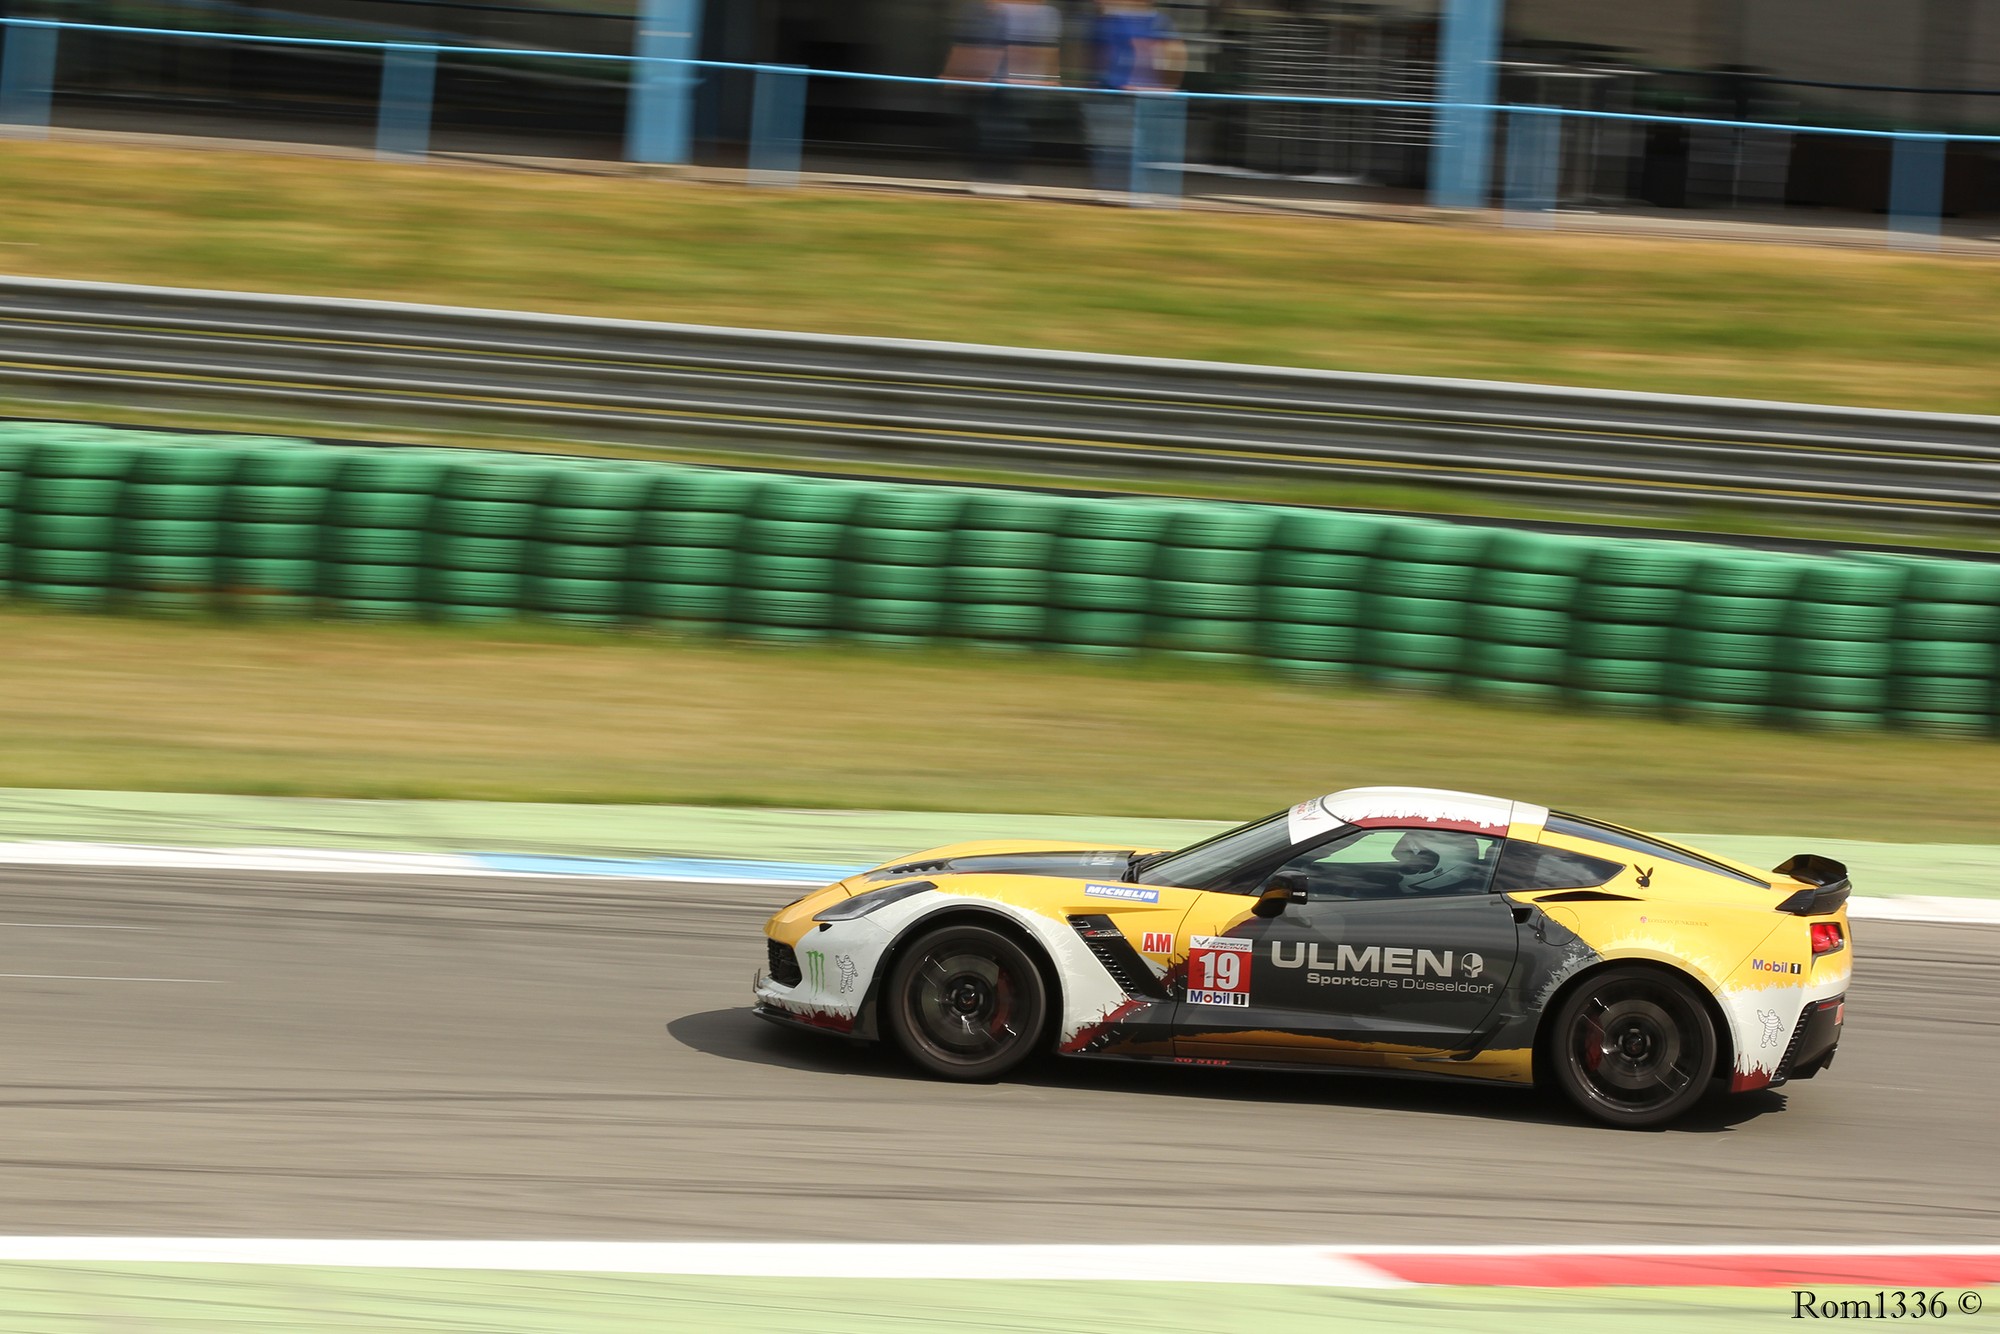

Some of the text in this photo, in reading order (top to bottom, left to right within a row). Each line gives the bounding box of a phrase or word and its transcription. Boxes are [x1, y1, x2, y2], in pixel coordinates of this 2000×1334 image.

[1086, 886, 1157, 900] MICHELIN
[1143, 933, 1171, 952] AM
[1271, 941, 1453, 977] ULMEN
[1752, 959, 1788, 973] Mobil
[1199, 952, 1240, 990] 19
[1307, 972, 1494, 994] Sportcars Düsseldorf
[1190, 990, 1230, 1004] Mobil
